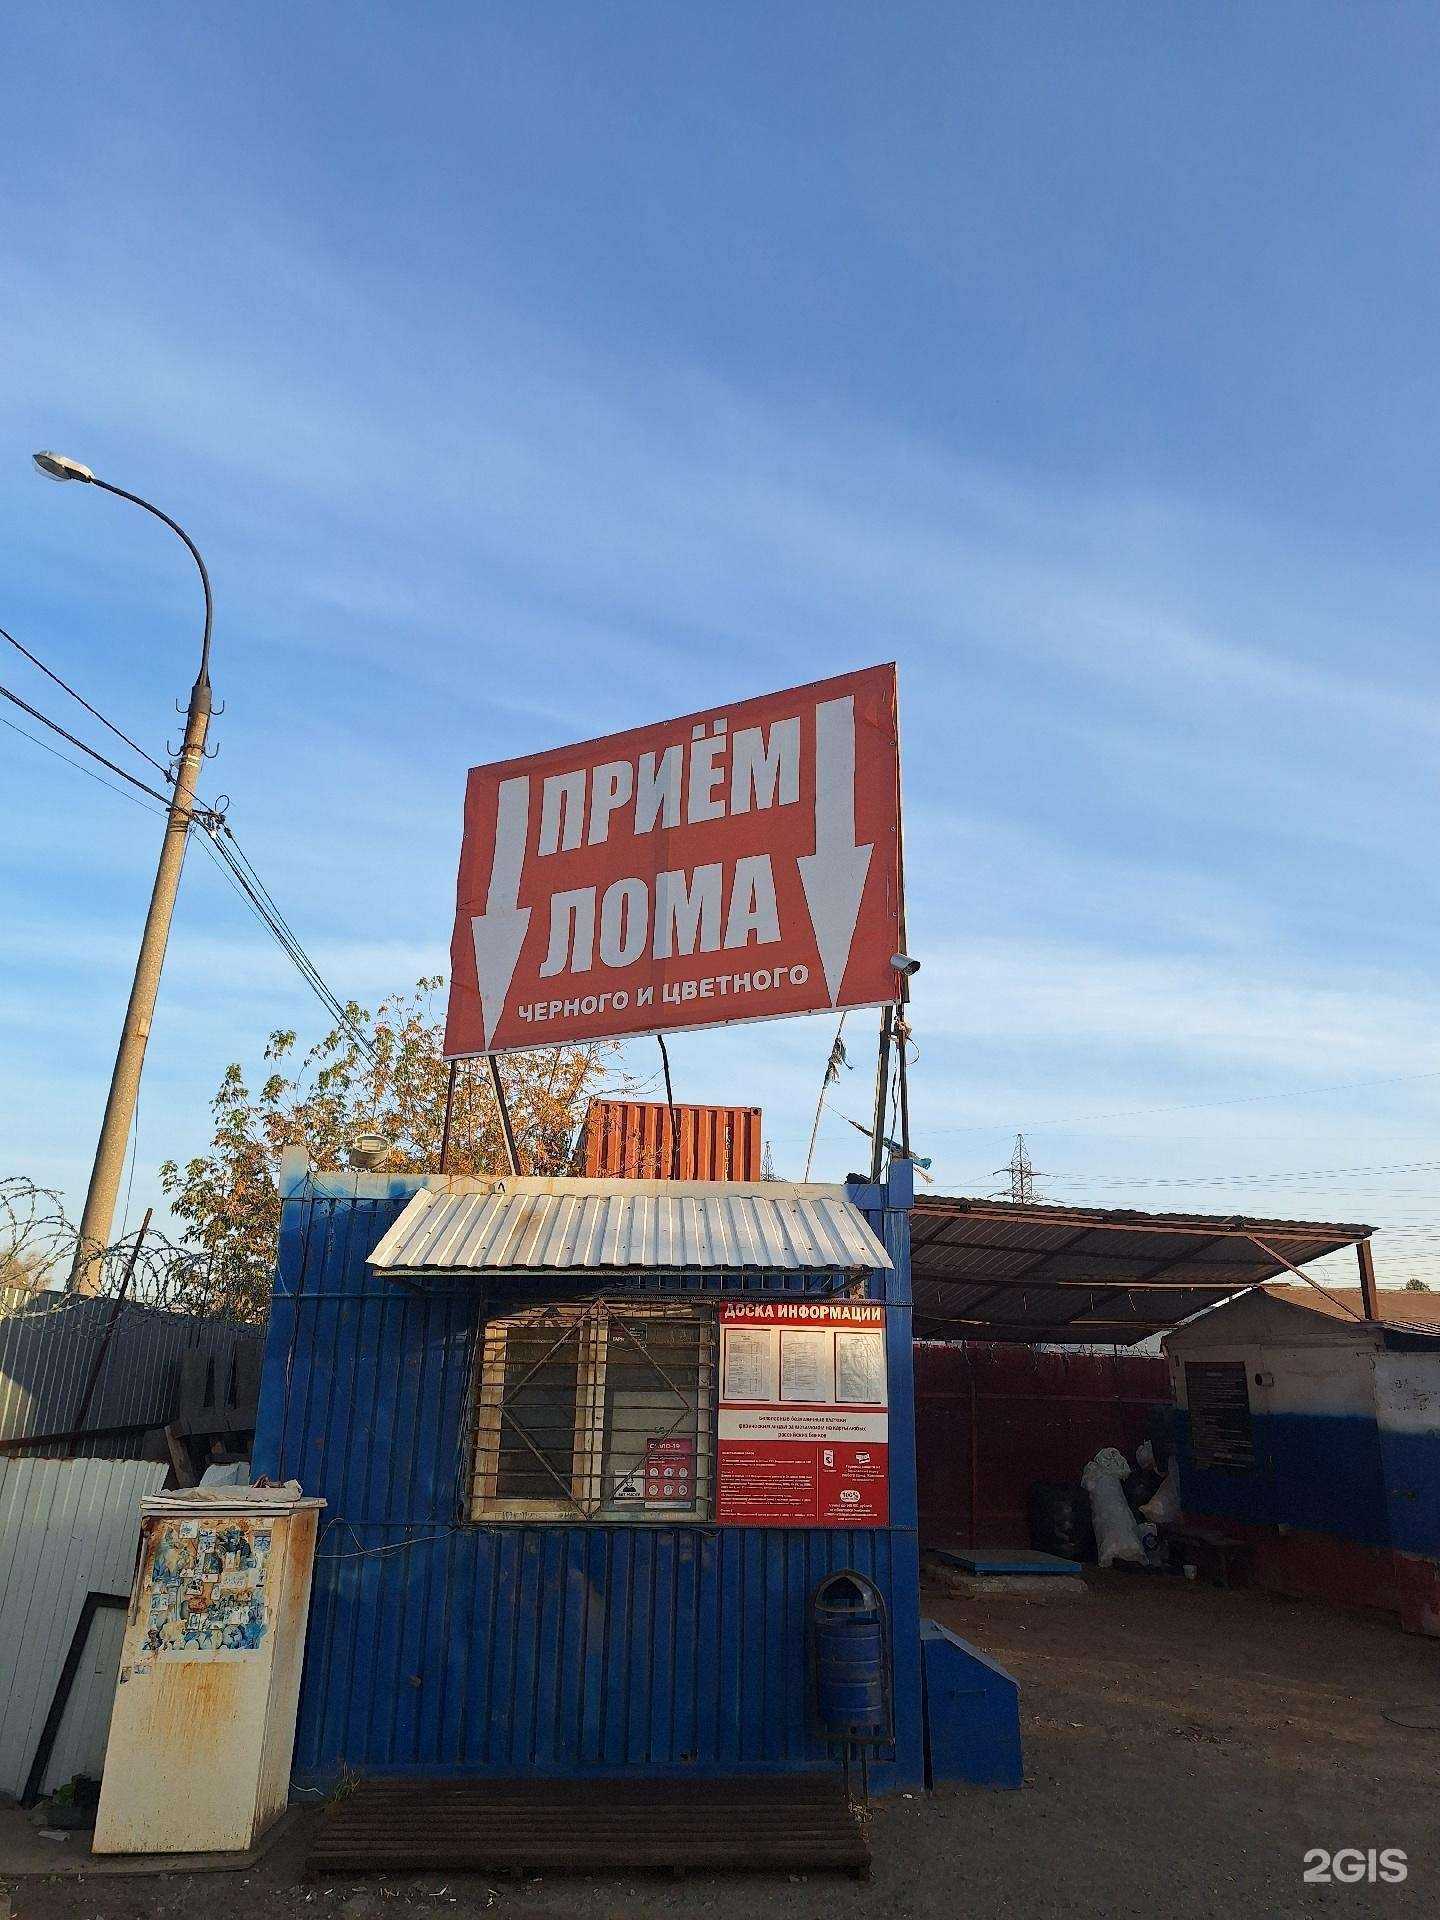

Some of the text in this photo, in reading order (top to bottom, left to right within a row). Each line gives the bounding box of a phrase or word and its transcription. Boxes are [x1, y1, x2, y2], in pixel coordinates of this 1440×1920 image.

[538, 717, 801, 857] ПРИЁМ
[539, 854, 782, 979] ЛОМА
[517, 964, 810, 1023] ЧЕРНОГО И ЦВЕТНОГО
[724, 1303, 881, 1323] ДОСКА ИНФОРМАЦИИ
